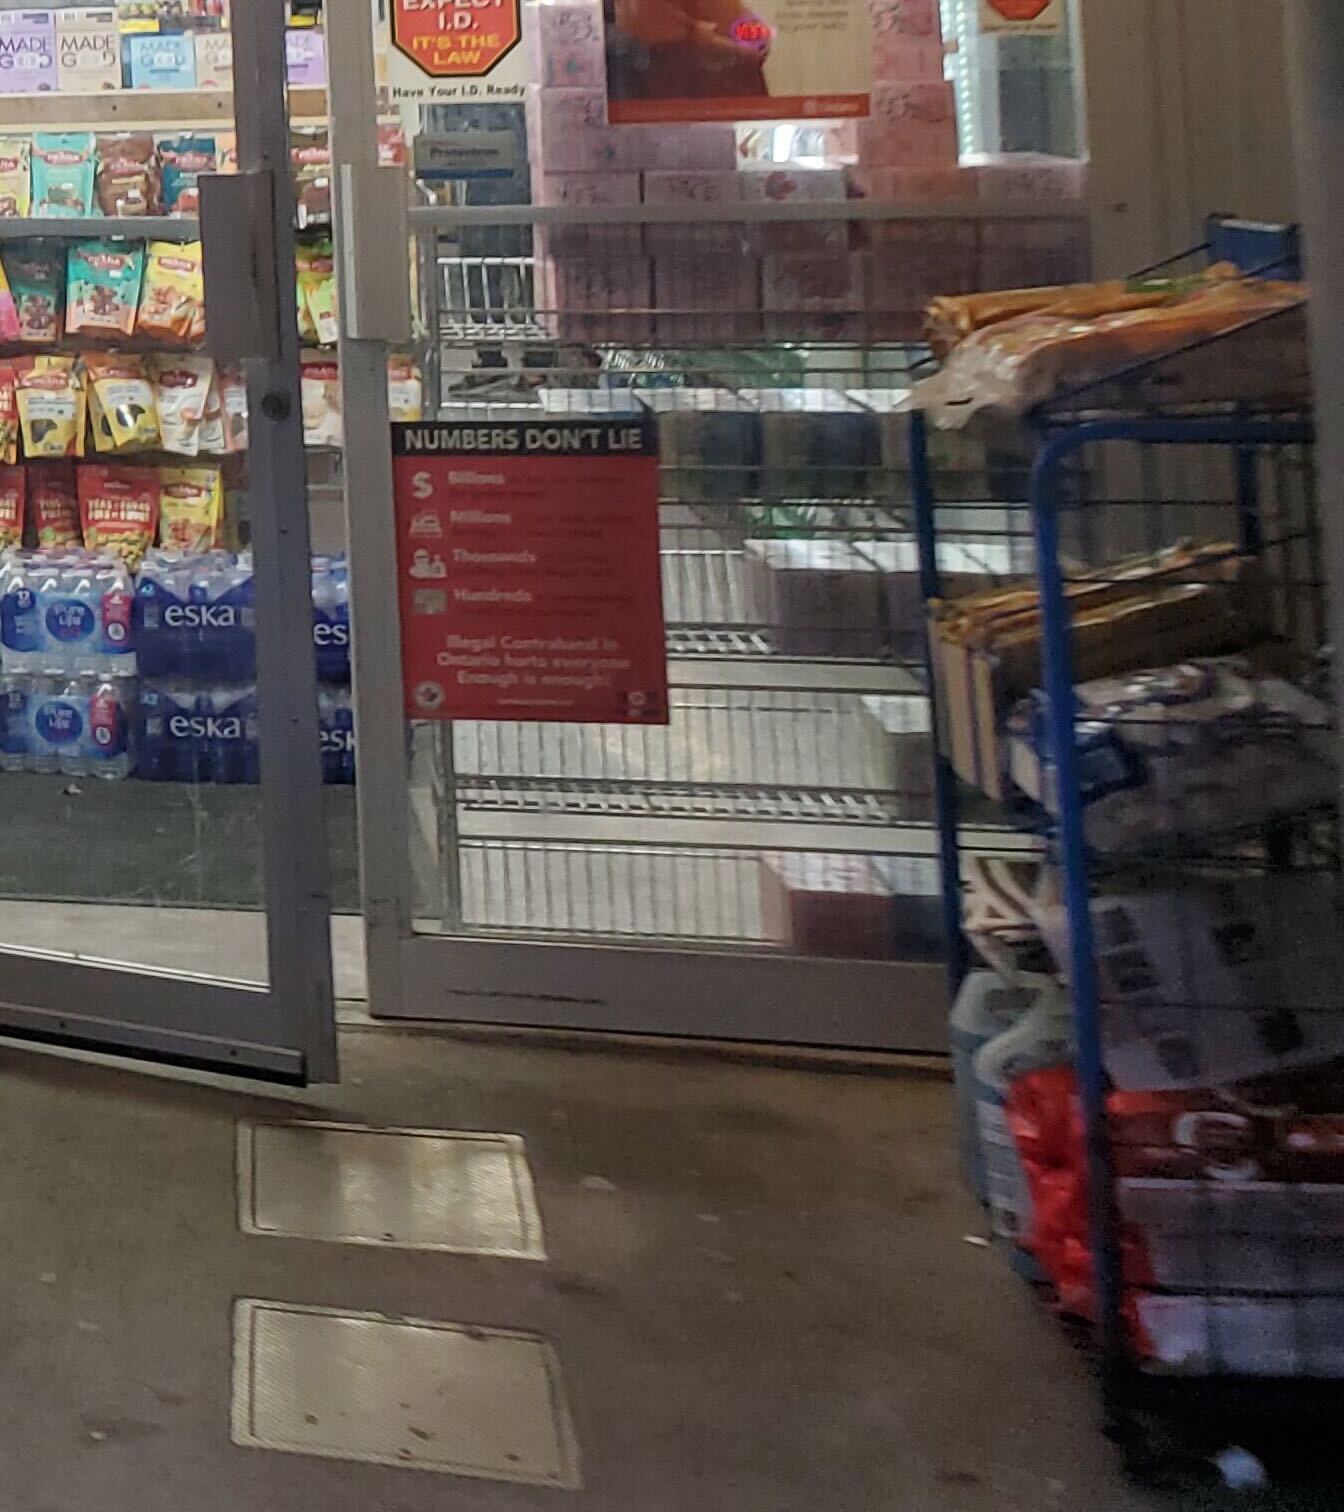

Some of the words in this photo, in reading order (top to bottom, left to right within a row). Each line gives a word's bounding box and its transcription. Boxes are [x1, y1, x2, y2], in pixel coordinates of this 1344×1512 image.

[438, 10, 480, 31] I.D.
[61, 36, 114, 51] MADE
[413, 35, 453, 52] IT'S
[460, 33, 501, 49] THE
[433, 50, 481, 66] LAW
[393, 86, 424, 98] Have
[428, 85, 458, 97] Your
[405, 428, 519, 451] NUMBERS
[525, 428, 601, 450] DON'T
[608, 428, 643, 450] LIE
[58, 614, 81, 627] Life
[164, 605, 235, 627] eska
[169, 715, 240, 738] eska
